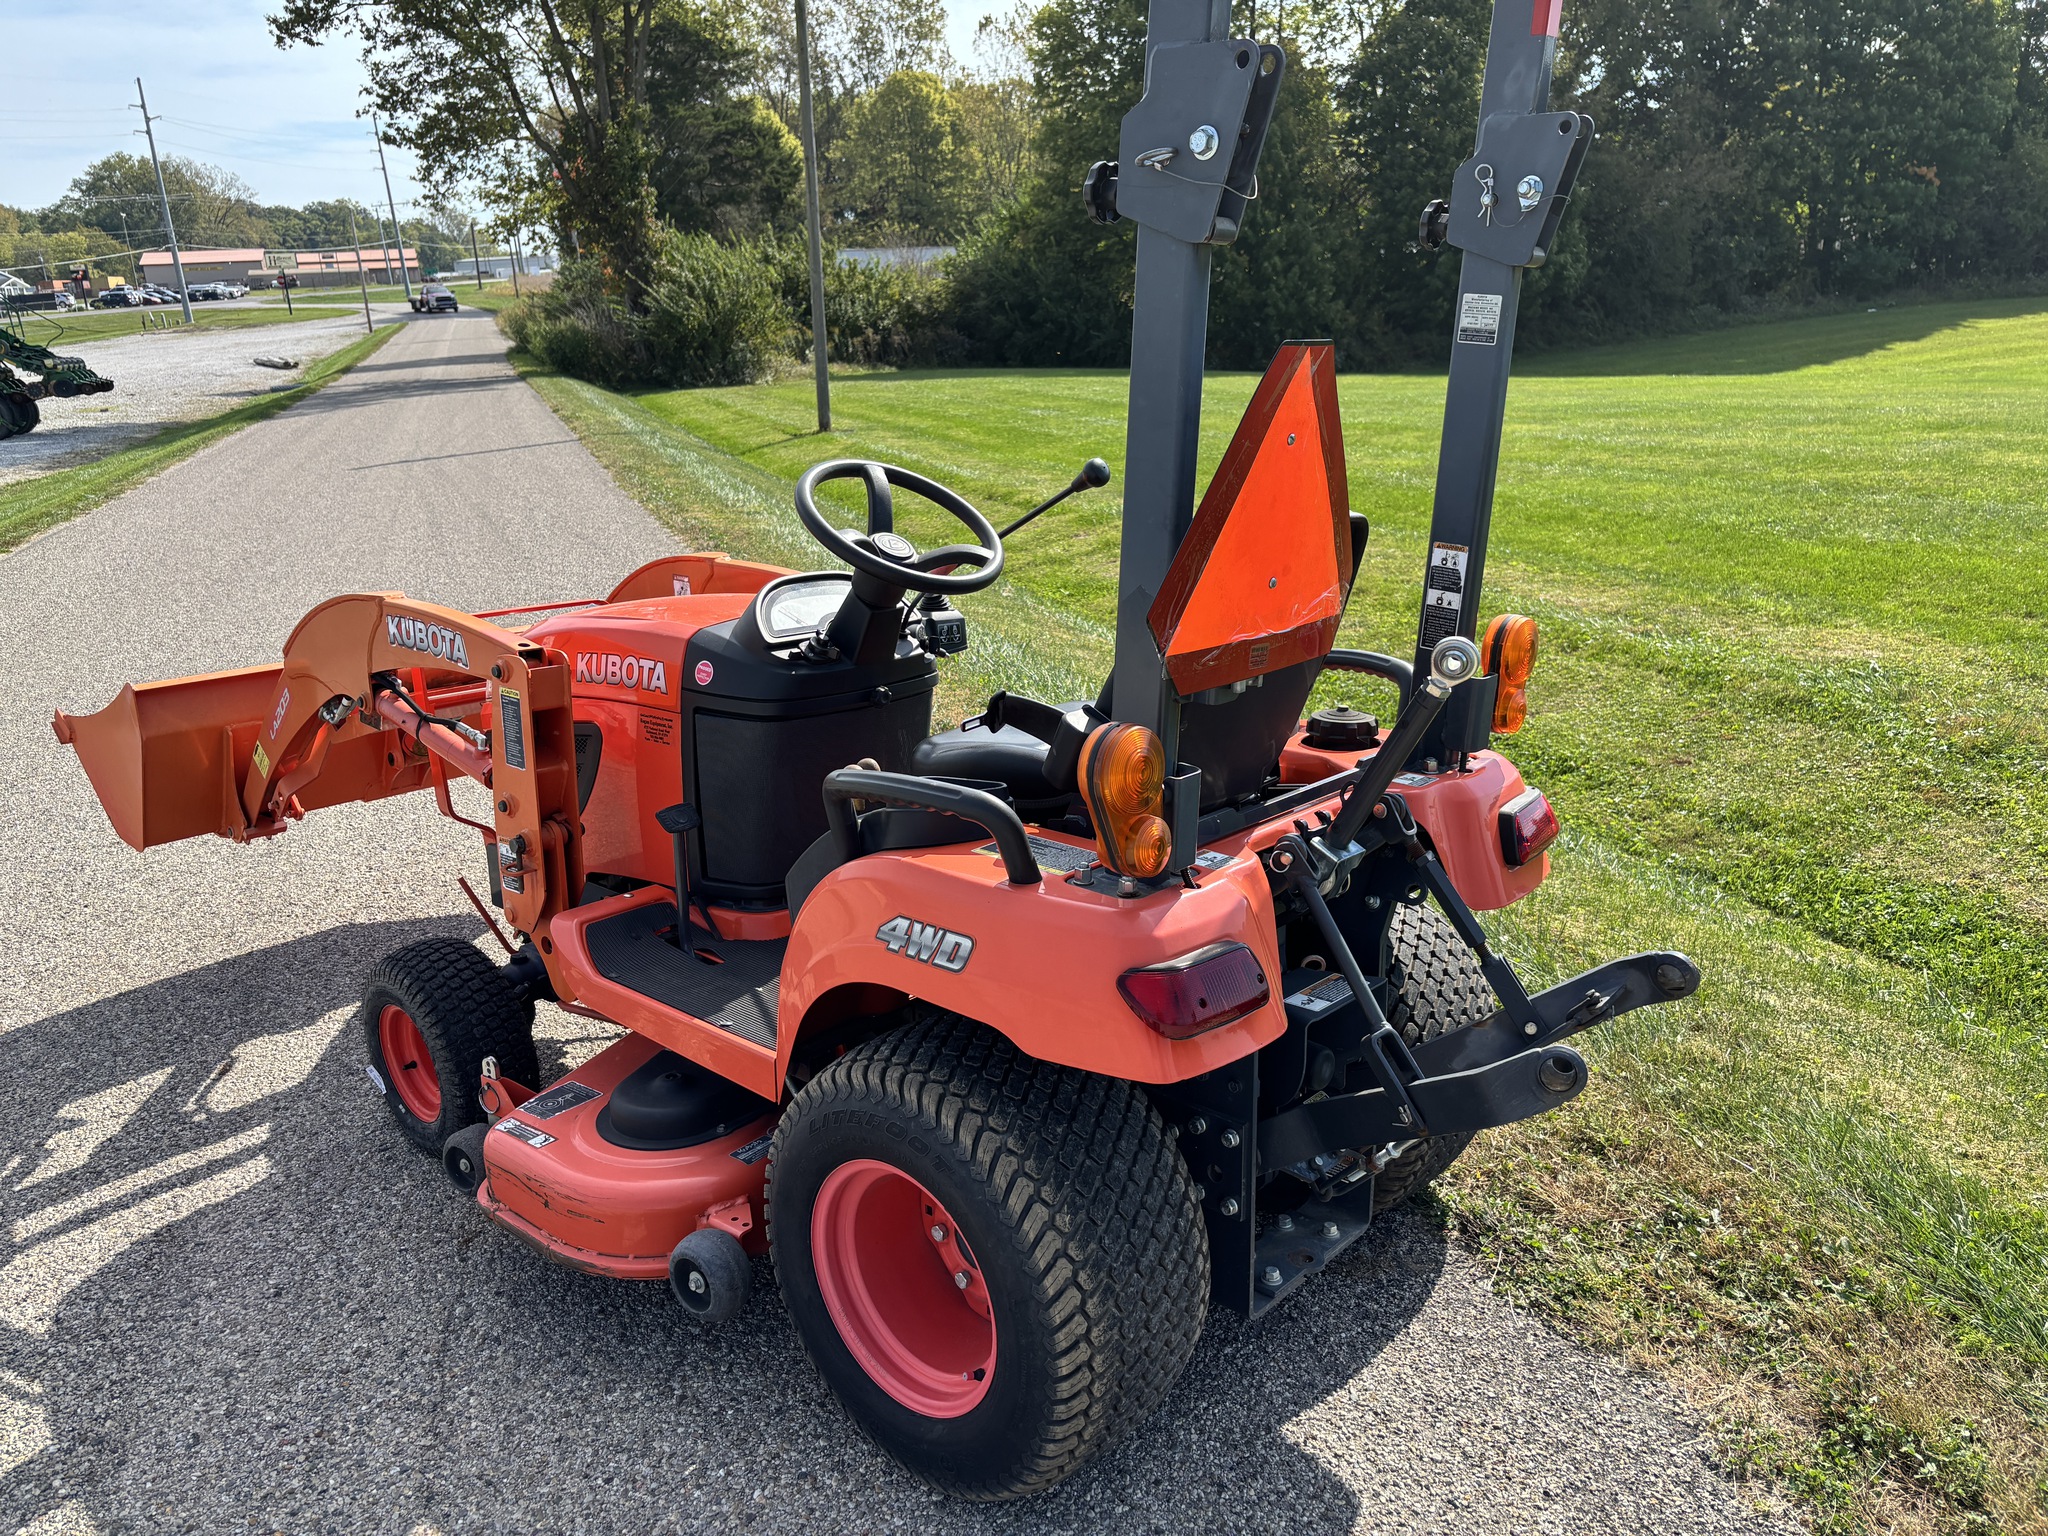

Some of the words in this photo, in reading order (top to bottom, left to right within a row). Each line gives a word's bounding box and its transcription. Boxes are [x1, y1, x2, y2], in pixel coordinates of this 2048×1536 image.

[386, 614, 470, 670] KUBOTA
[503, 688, 519, 697] CAUTION
[576, 652, 669, 695] KUBOTA
[875, 914, 976, 974] 4WD
[808, 1107, 956, 1175] LITEFOOT
